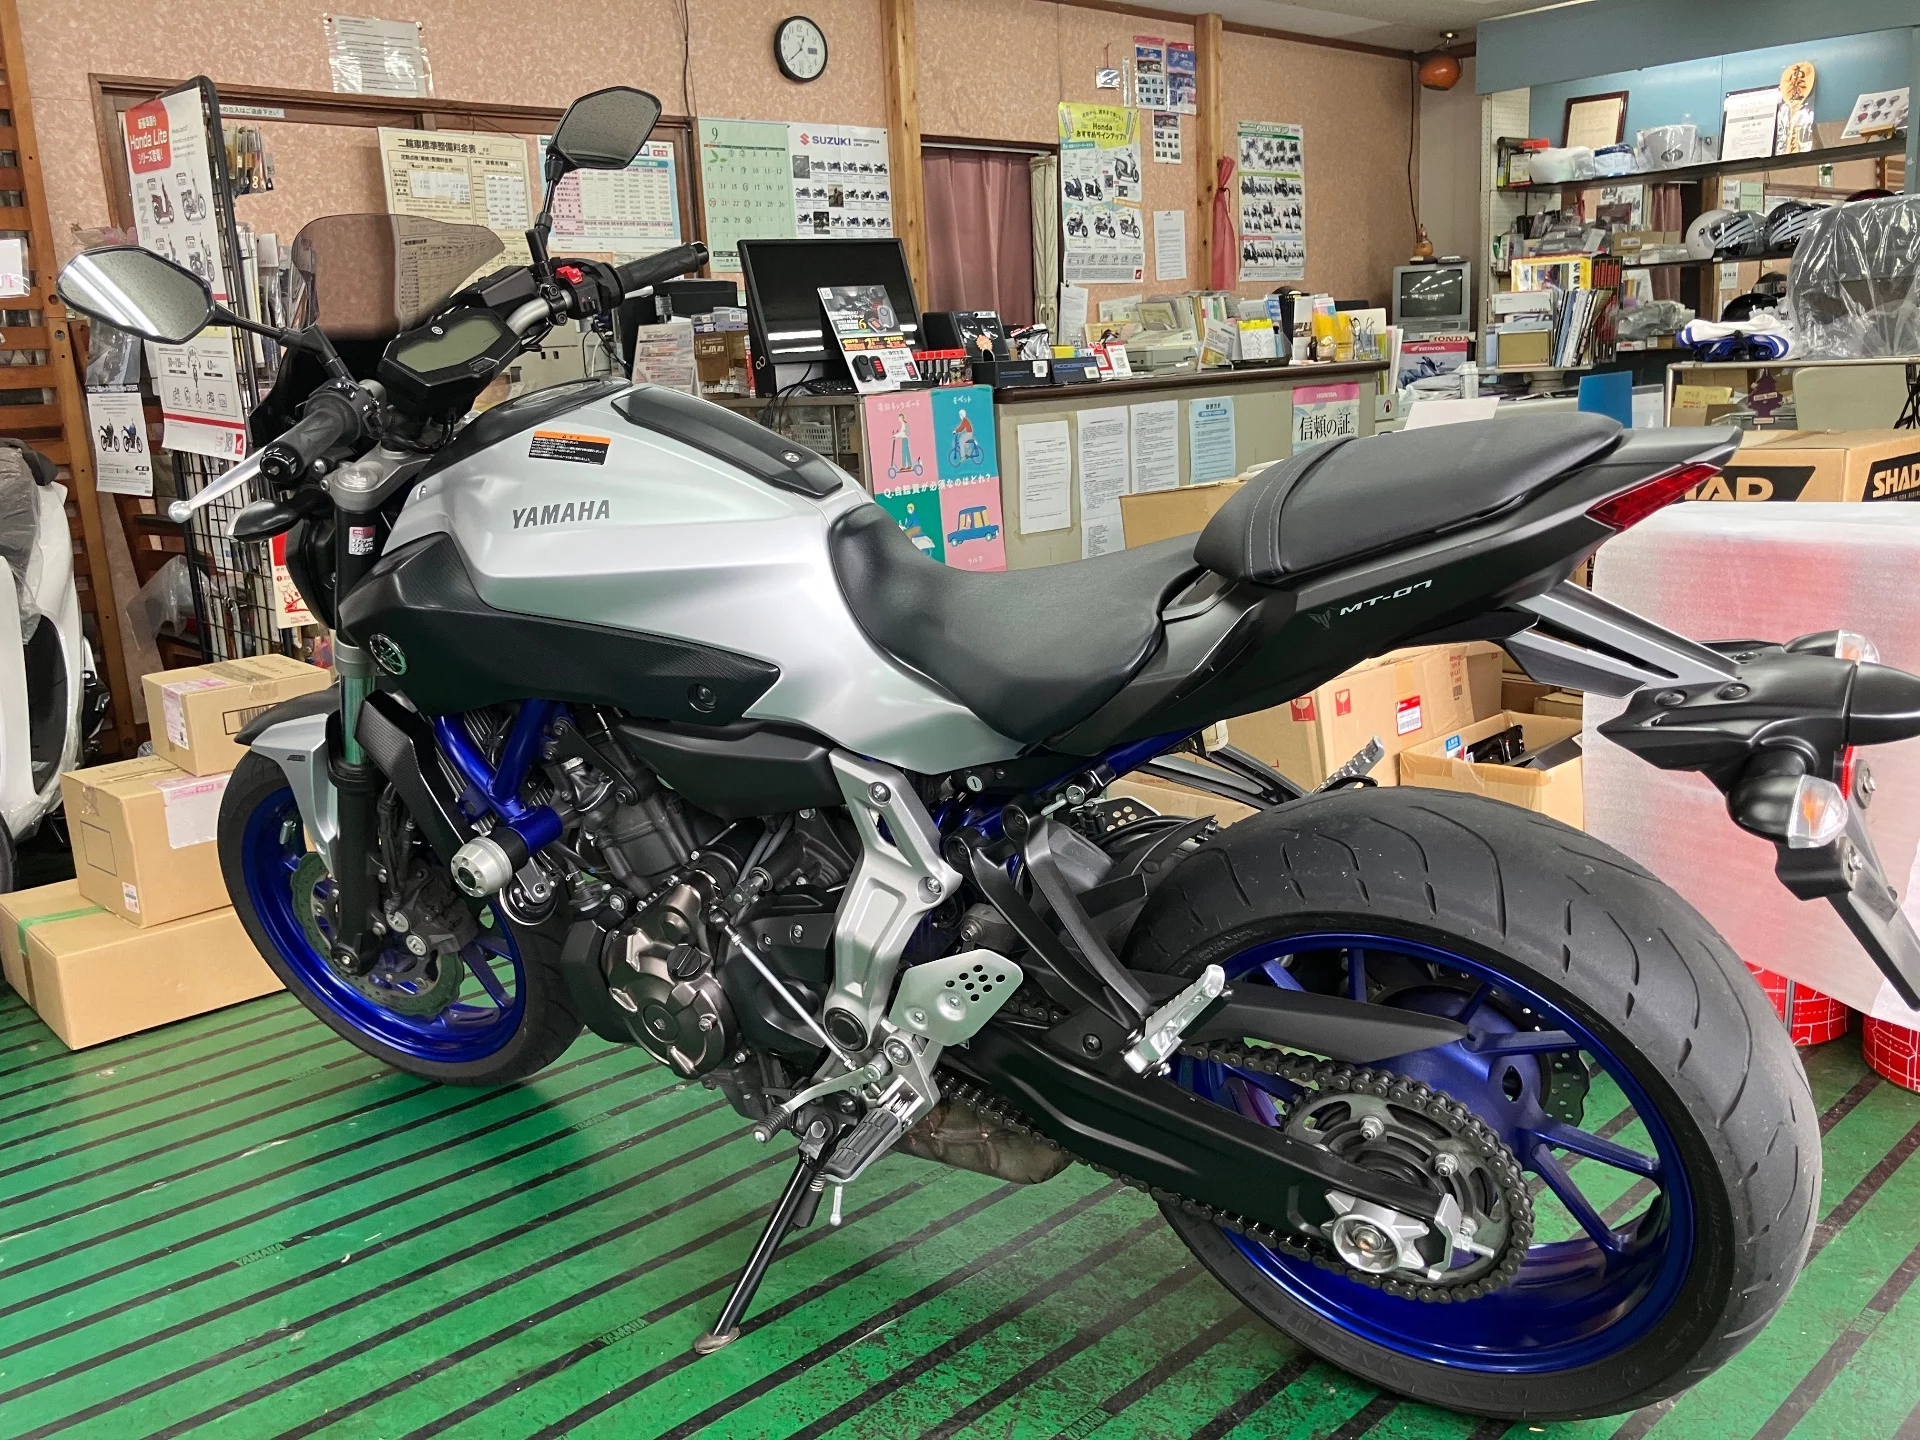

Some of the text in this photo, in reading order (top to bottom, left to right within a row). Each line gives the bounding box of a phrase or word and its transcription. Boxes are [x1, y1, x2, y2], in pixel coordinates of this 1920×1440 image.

[711, 127, 718, 141] 9
[1093, 123, 1112, 131] Honda
[129, 132, 152, 150] Honda
[153, 129, 167, 146] Lite
[398, 139, 477, 154] 二輪車標準整備料金表
[812, 135, 851, 146] SUZUKI
[1299, 412, 1354, 441] 信頼の証。
[512, 499, 610, 529] YAMAHA
[1340, 580, 1432, 616] MT-07
[234, 1243, 286, 1267] YAMAHA
[598, 1317, 650, 1346] YAMAHA
